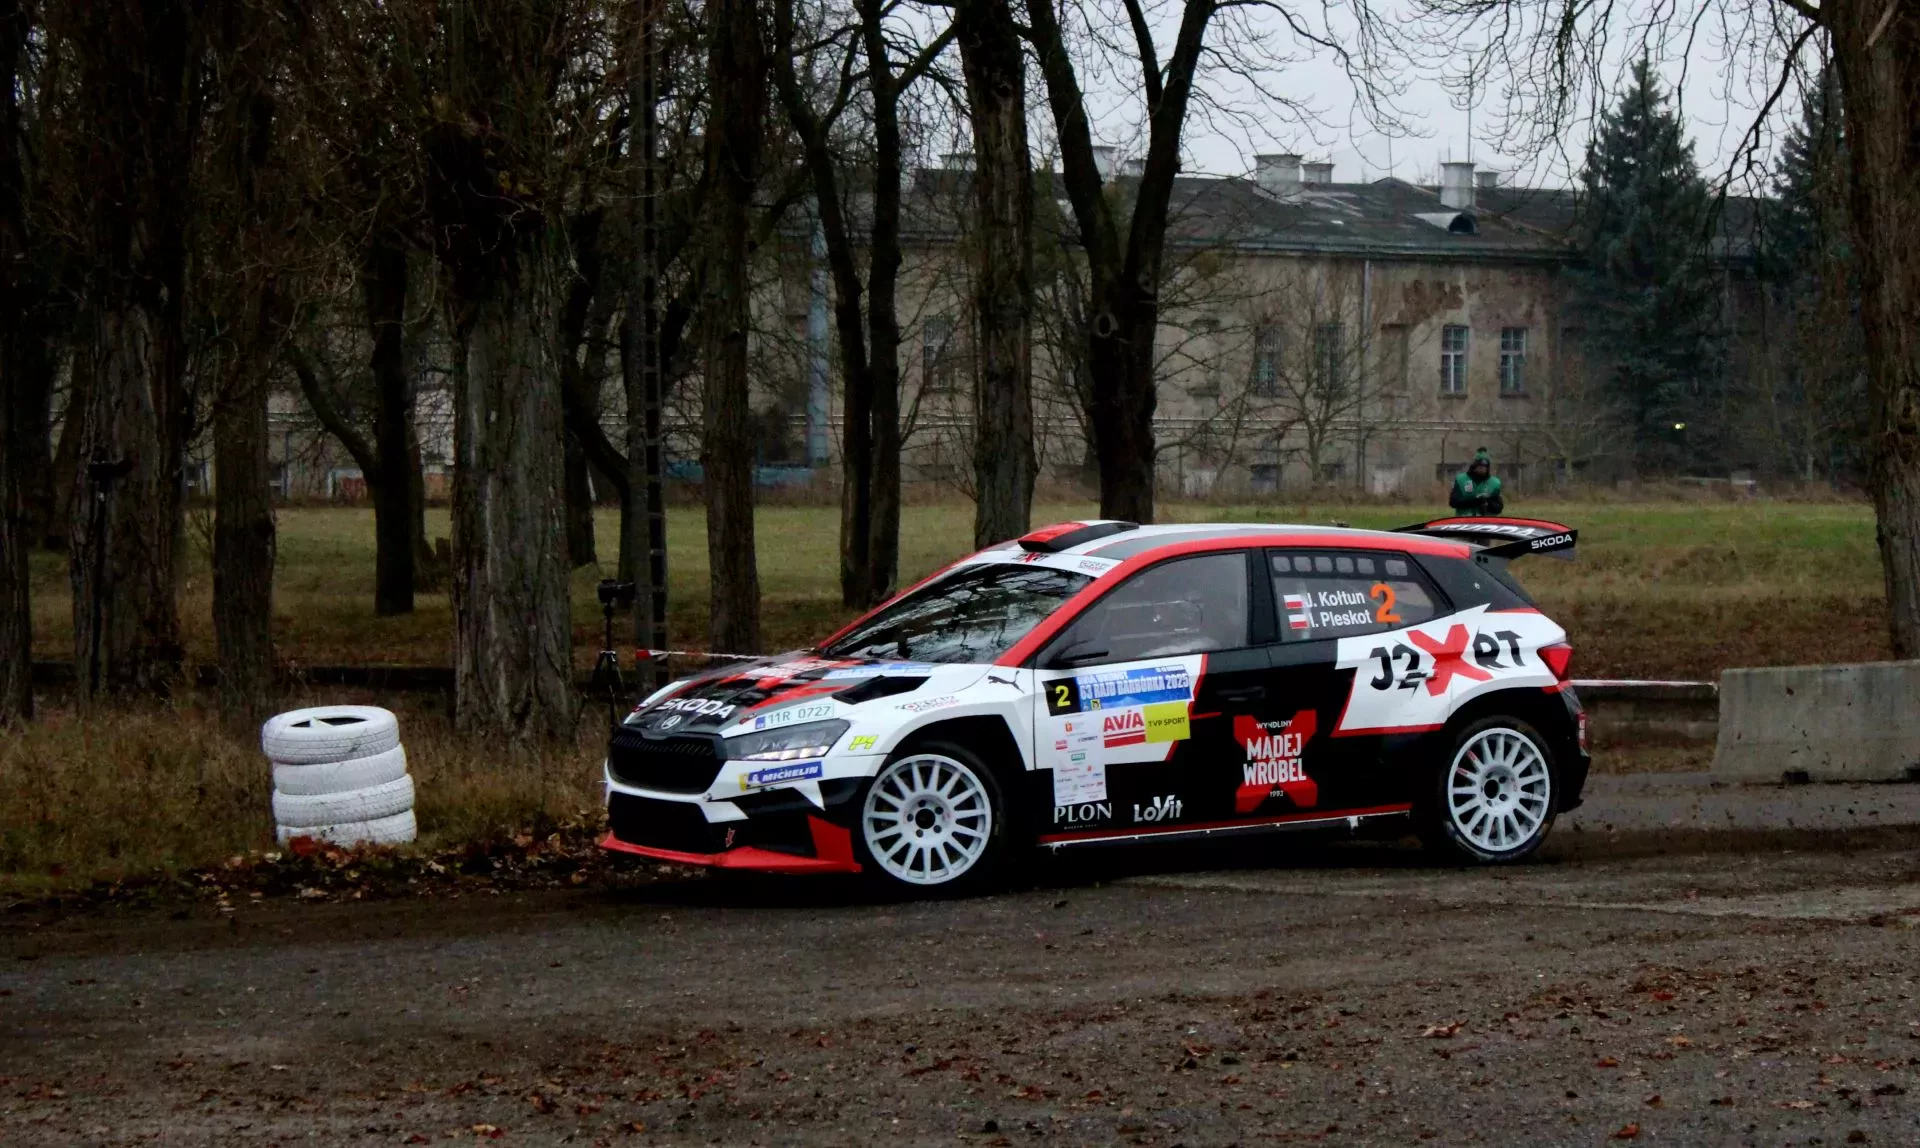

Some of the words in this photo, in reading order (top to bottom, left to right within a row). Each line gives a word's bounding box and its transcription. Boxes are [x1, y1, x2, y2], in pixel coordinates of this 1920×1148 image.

[1531, 534, 1573, 549] SKODA
[1320, 590, 1366, 607] Kołtun
[1368, 583, 1402, 623] 2
[1320, 609, 1373, 627] Pleskot
[1093, 681, 1117, 698] RAJD
[1165, 673, 1190, 690] 2025
[1055, 685, 1071, 707] 2
[768, 710, 790, 725] 11R
[797, 705, 832, 719] 0727
[1148, 719, 1162, 727] TVP
[1164, 717, 1186, 726] SPORT
[1246, 733, 1302, 761] MADEJ
[762, 766, 819, 782] MICHELIN
[1243, 758, 1307, 786] WRÓBEL
[1053, 803, 1112, 824] PLON
